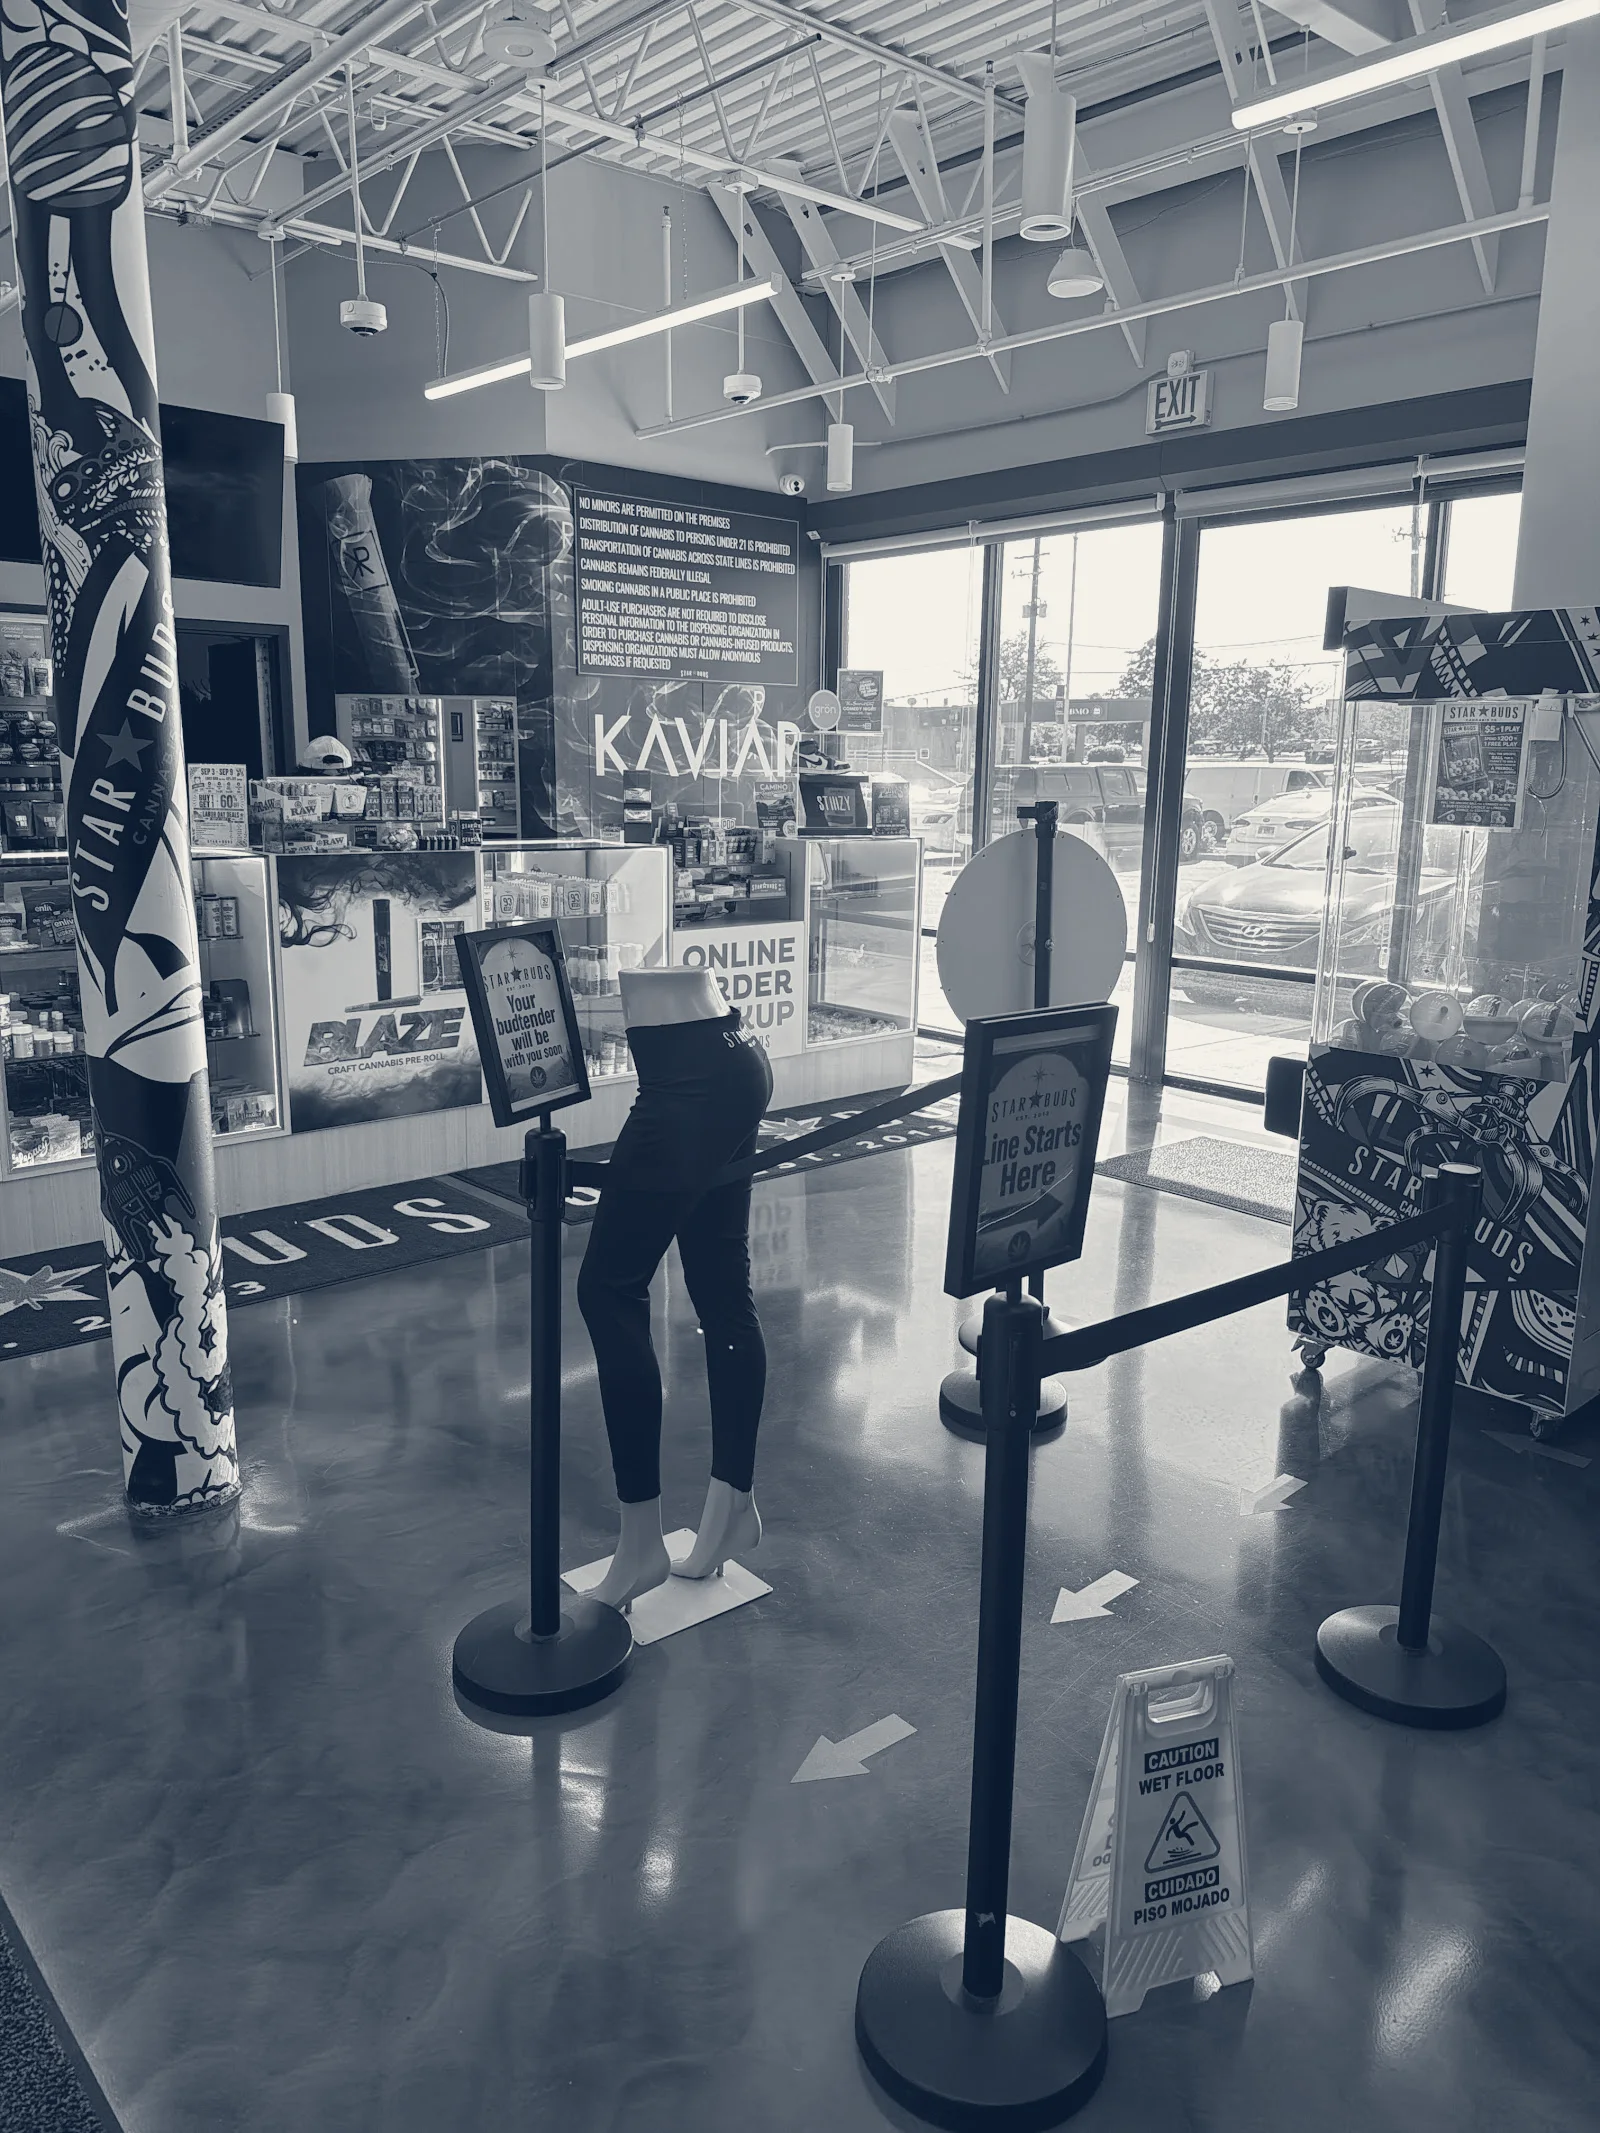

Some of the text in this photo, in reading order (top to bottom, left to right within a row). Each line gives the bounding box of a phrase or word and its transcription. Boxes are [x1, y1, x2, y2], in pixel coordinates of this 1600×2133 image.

[1155, 375, 1200, 419] EXIT
[579, 496, 730, 528] NO MINORS ARE PERMITTED ON THE PREMISES
[579, 517, 790, 555] DISTRIBUTION OF CANNABIS TO PERSONS UNDER 21 IS PROHIBITED
[579, 537, 795, 574] TRANSPORTATION OF CANNABIS ACROSS STATE LINES IS PROHIBITED
[580, 558, 710, 583] CANNABIS REMAINS FEDERALLY ILLEGAL
[580, 578, 755, 606] SMOKING CANNABIS IN A PUBLIC PLACE IS PROHIBITED
[581, 598, 766, 625] ADULT-USE PURCHASERS ARE NOT REQUIRED TO DISCLOSE
[581, 612, 779, 639] PERSONAL INFORMATION TO THE DISPENSING ORGANIZATION IN
[582, 626, 605, 638] ORDER
[607, 628, 616, 639] TO
[618, 628, 654, 642] PURCHASE
[656, 631, 688, 644] CANNABIS
[689, 634, 699, 645] OR
[701, 635, 759, 649] CANNABIS-INFUSED
[582, 639, 760, 662] DISPENSING ORGANIZATIONS MUST ALLOW ANONYMOUS
[582, 653, 670, 669] PURCHASES IF REQUESTED
[814, 703, 836, 718] grön
[1069, 707, 1089, 716] BMO
[1450, 706, 1519, 719] STAR BUDS
[1484, 725, 1496, 733] $5
[290, 805, 317, 816] RAW
[72, 777, 137, 912] STAR
[322, 837, 344, 847] RAW
[54, 918, 74, 928] enliv
[683, 937, 795, 969] ONLINE
[483, 964, 551, 993] STAR BUDS
[716, 970, 793, 1001] RDER
[506, 992, 537, 1011] Your
[496, 1008, 556, 1036] budtender
[304, 1007, 466, 1066] BLAZE
[511, 1029, 550, 1051] will be
[327, 1053, 445, 1075] CRAFT CANNABIS PRE-ROLL
[504, 1044, 564, 1069] with you soon
[991, 1087, 1078, 1123] STAR BUDS
[856, 1124, 955, 1150] 2013
[1024, 1120, 1083, 1156] Starts
[999, 1160, 1057, 1197] Here
[1348, 1145, 1534, 1275] STAR UDS
[223, 1197, 492, 1266] UDS
[1147, 1741, 1216, 1771] CAUTION
[1139, 1762, 1225, 1796] WET FLOOR
[1147, 1868, 1217, 1900] CUIDADO
[1133, 1887, 1231, 1926] PISO MOJADO
